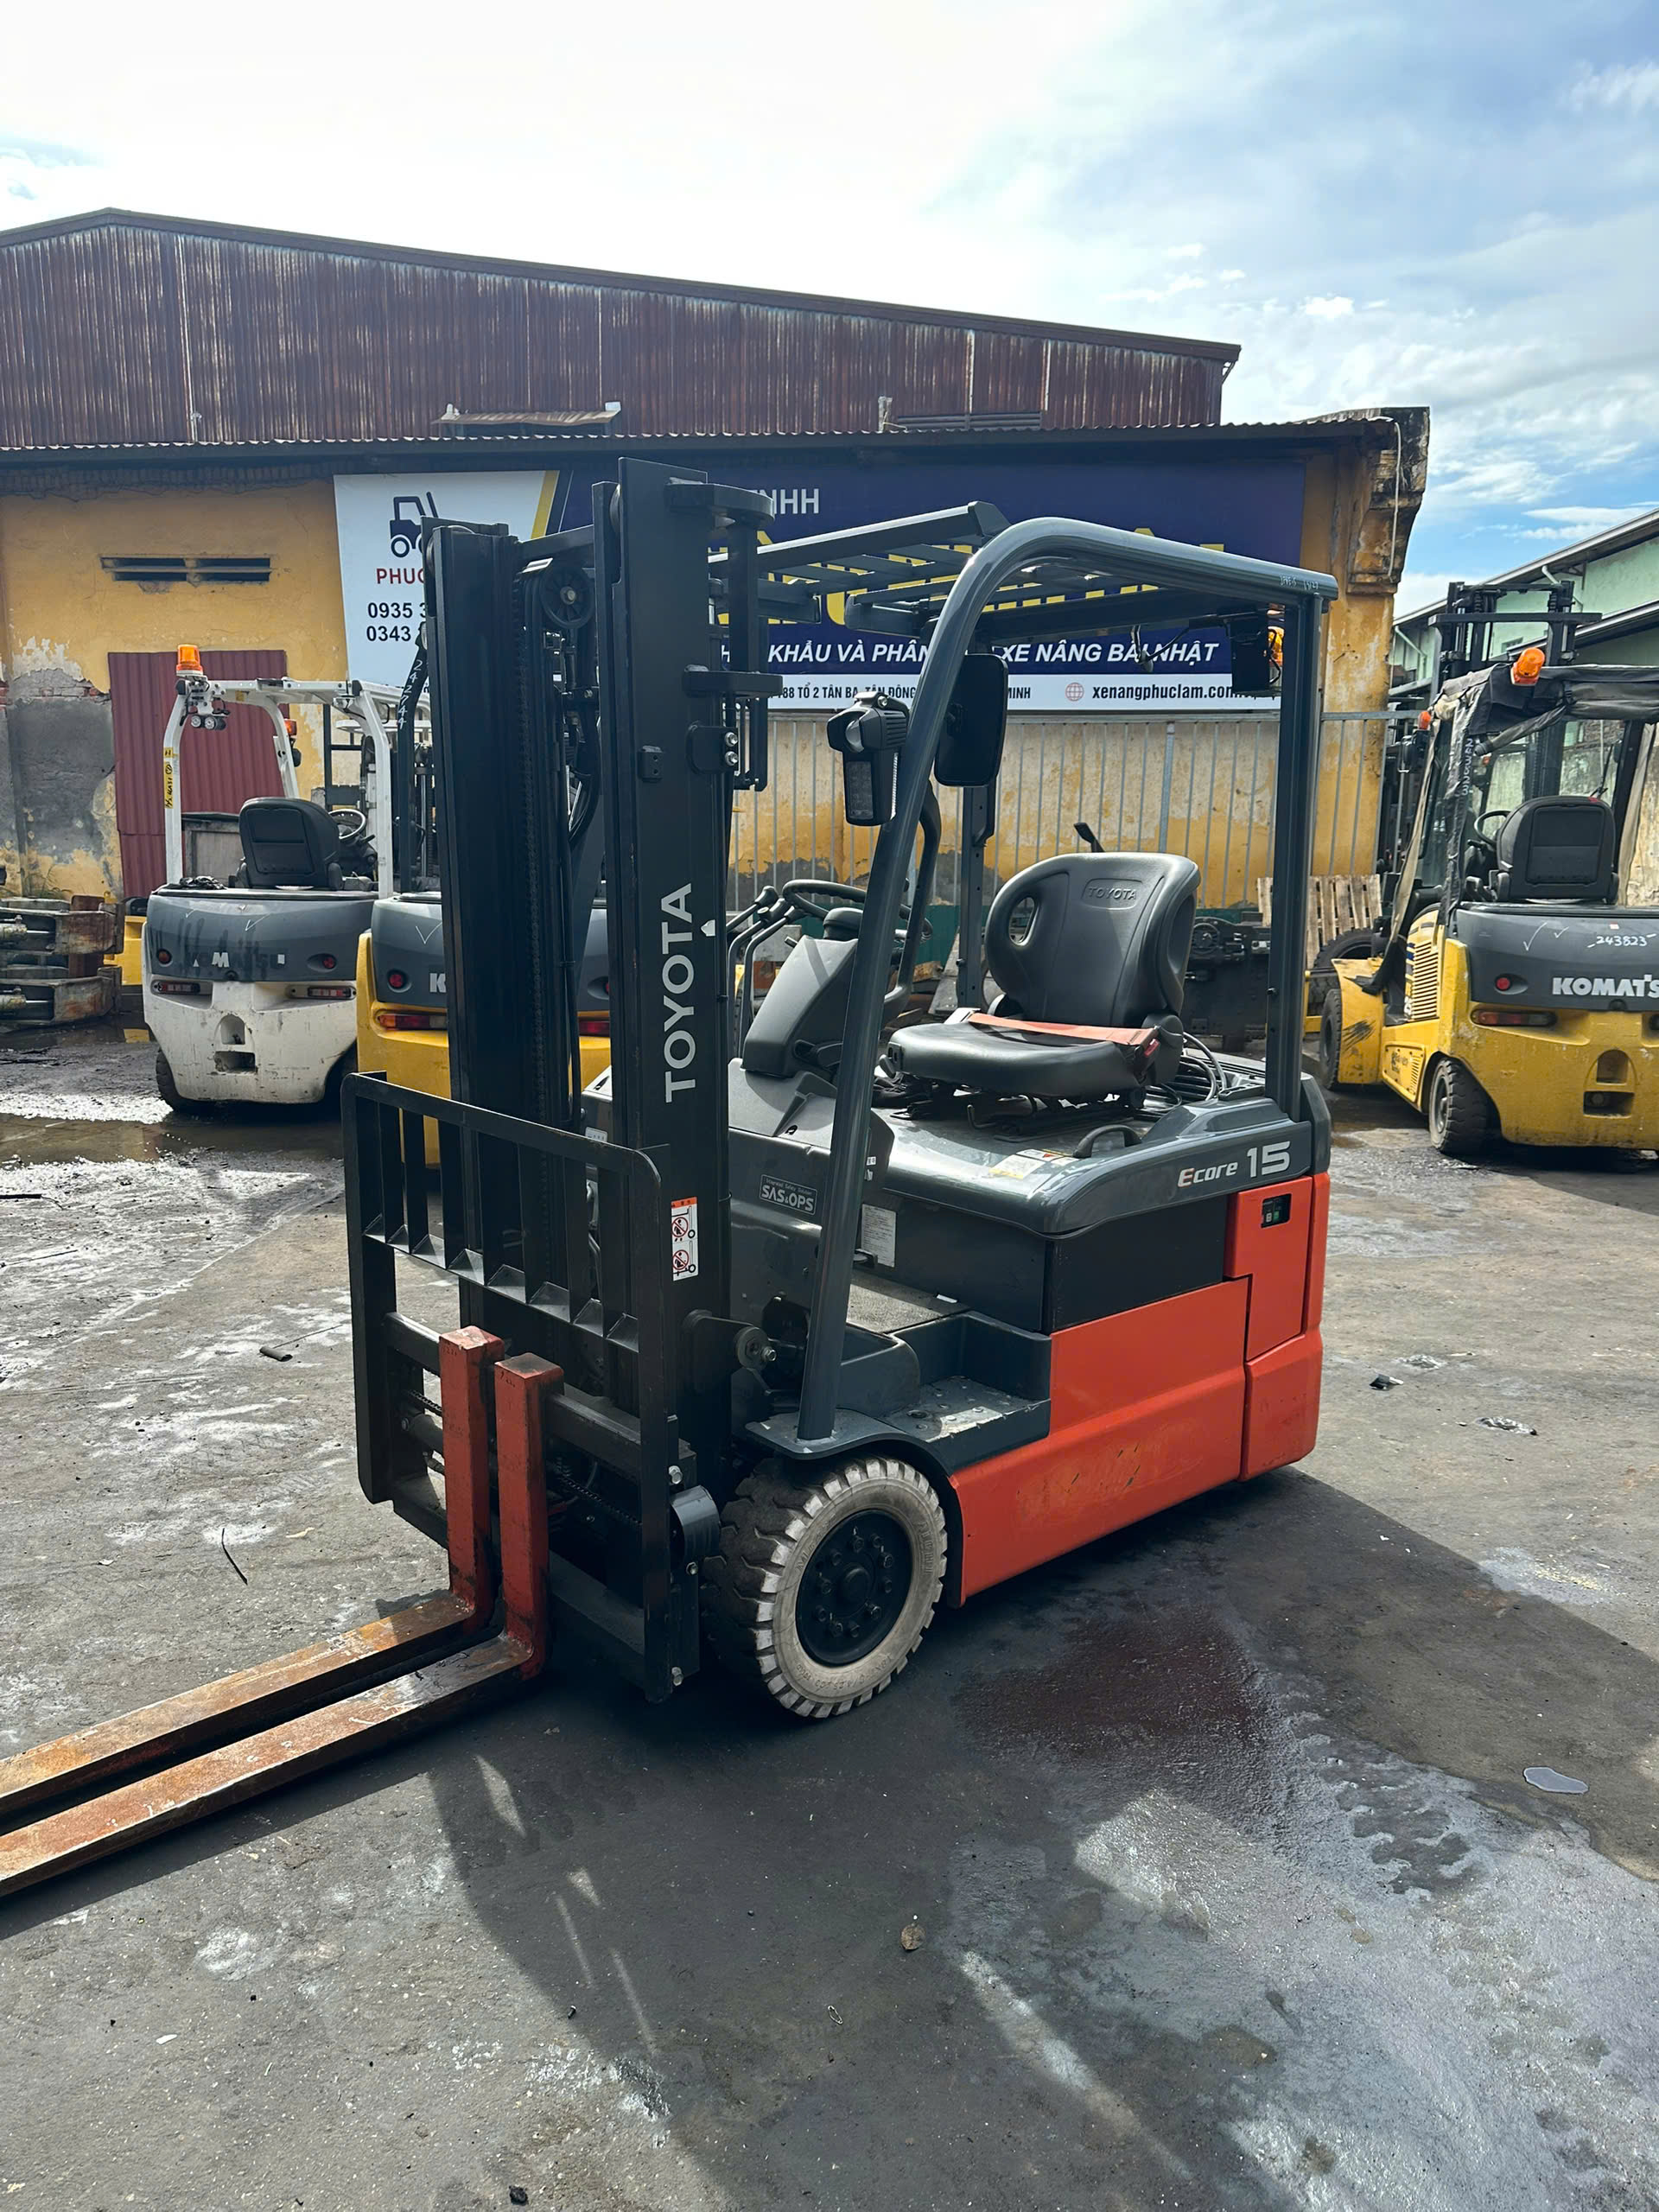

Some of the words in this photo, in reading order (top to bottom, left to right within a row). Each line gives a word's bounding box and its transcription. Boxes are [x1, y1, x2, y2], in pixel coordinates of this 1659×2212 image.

[367, 602, 413, 619] 0935
[366, 626, 411, 642] 0343
[767, 639, 832, 663] KHẨU
[837, 639, 866, 663] VÀ
[1001, 643, 1032, 663] XE
[1034, 639, 1103, 663] NÂNG
[1152, 640, 1220, 666] NHẬT
[778, 686, 795, 698] 88
[813, 686, 820, 698] 2
[823, 684, 842, 698] TÂN
[1089, 887, 1137, 900] TOYOTA
[661, 883, 696, 1103] TOYOTA
[1177, 1161, 1238, 1188] Ecore
[1247, 1141, 1291, 1178] 15
